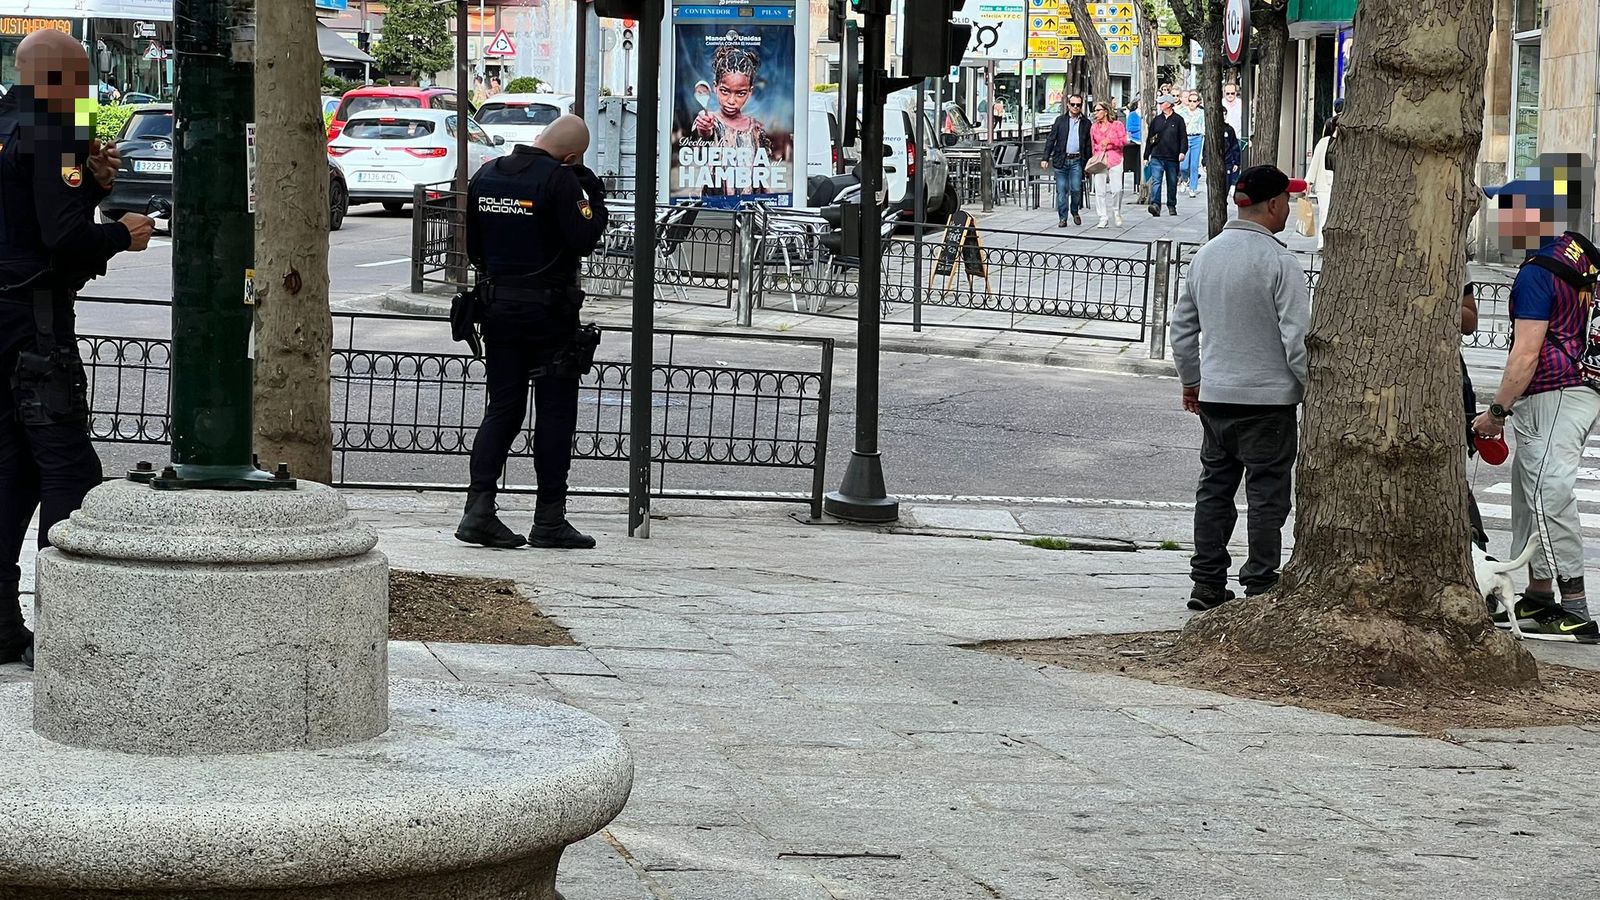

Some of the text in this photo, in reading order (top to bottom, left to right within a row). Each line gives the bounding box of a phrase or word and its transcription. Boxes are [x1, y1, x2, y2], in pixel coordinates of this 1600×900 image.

[685, 8, 731, 16] CONTENEDOR
[0, 17, 71, 35] VISTAHERMOSA
[678, 136, 715, 147] Declara
[678, 146, 783, 167] GUERRA al
[141, 162, 162, 170] 3229
[678, 166, 787, 189] HAMBRE
[478, 196, 521, 207] POLICIA
[478, 204, 533, 216] NACIONAL
